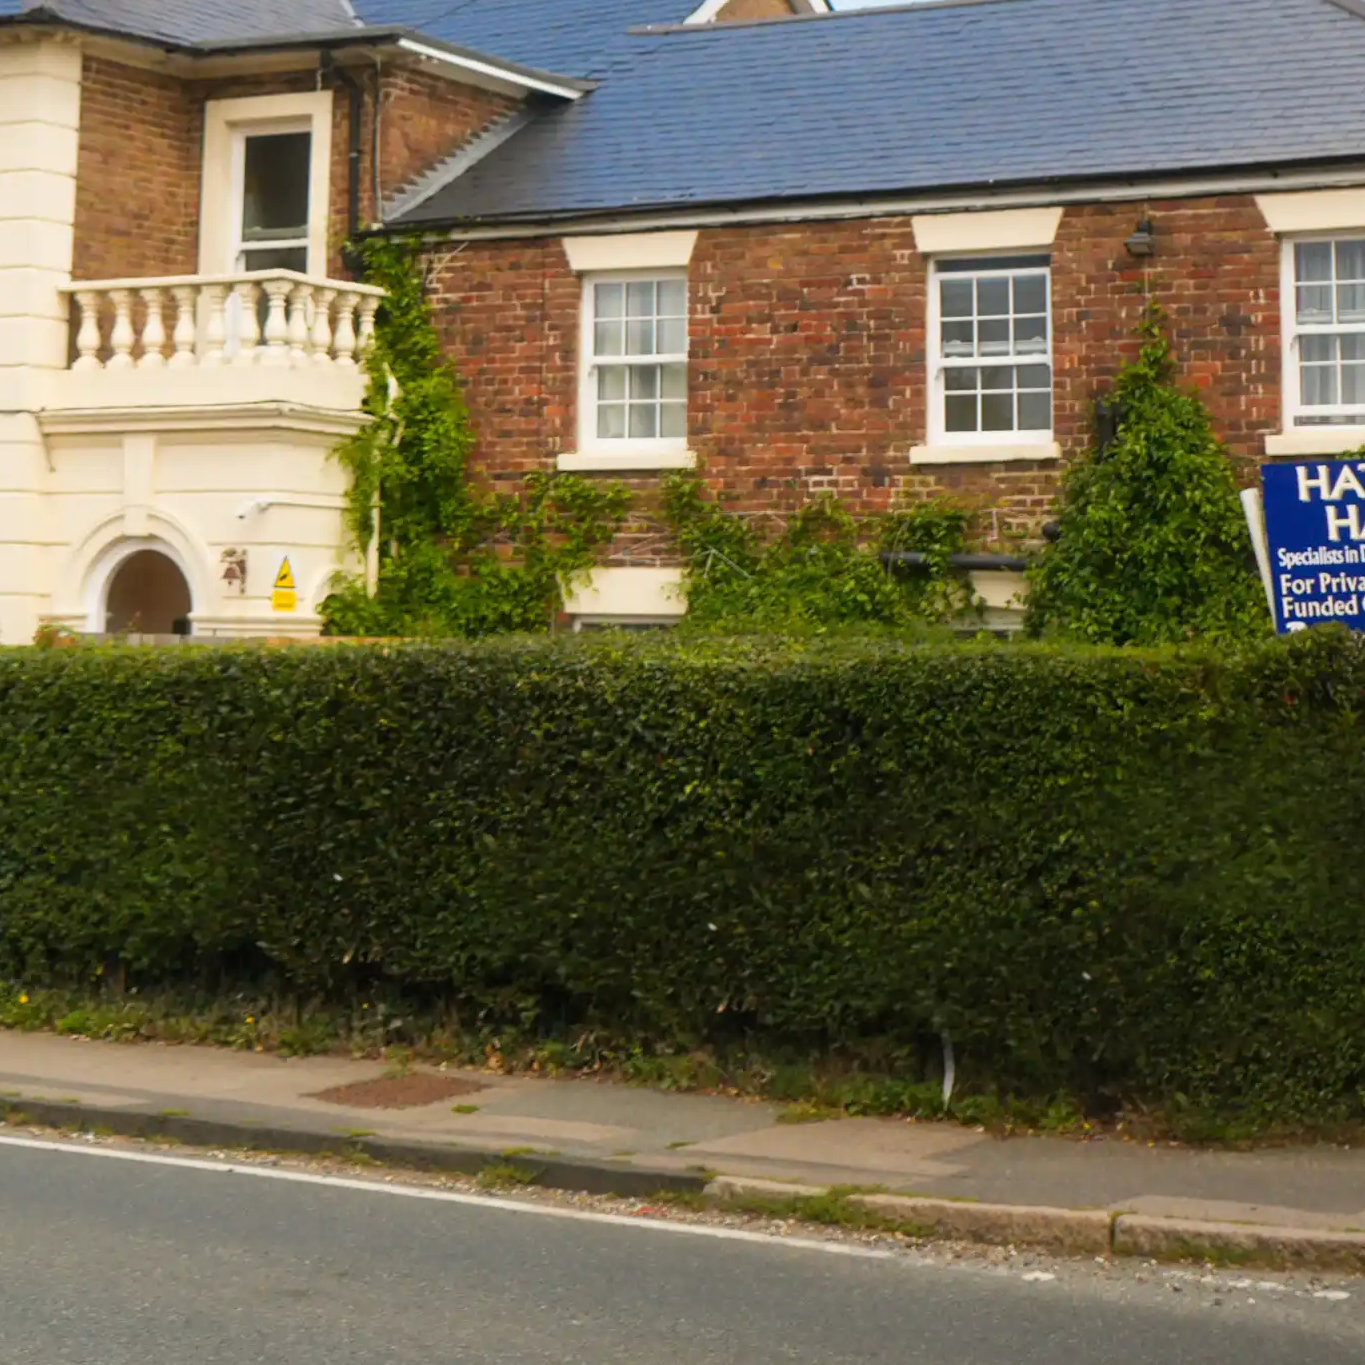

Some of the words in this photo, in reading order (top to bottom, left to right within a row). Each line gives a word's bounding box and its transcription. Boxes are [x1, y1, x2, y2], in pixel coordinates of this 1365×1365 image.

[1278, 545, 1345, 570] Specialists
[1344, 545, 1359, 563] in
[1280, 574, 1315, 595] For
[1282, 594, 1359, 618] Funded
